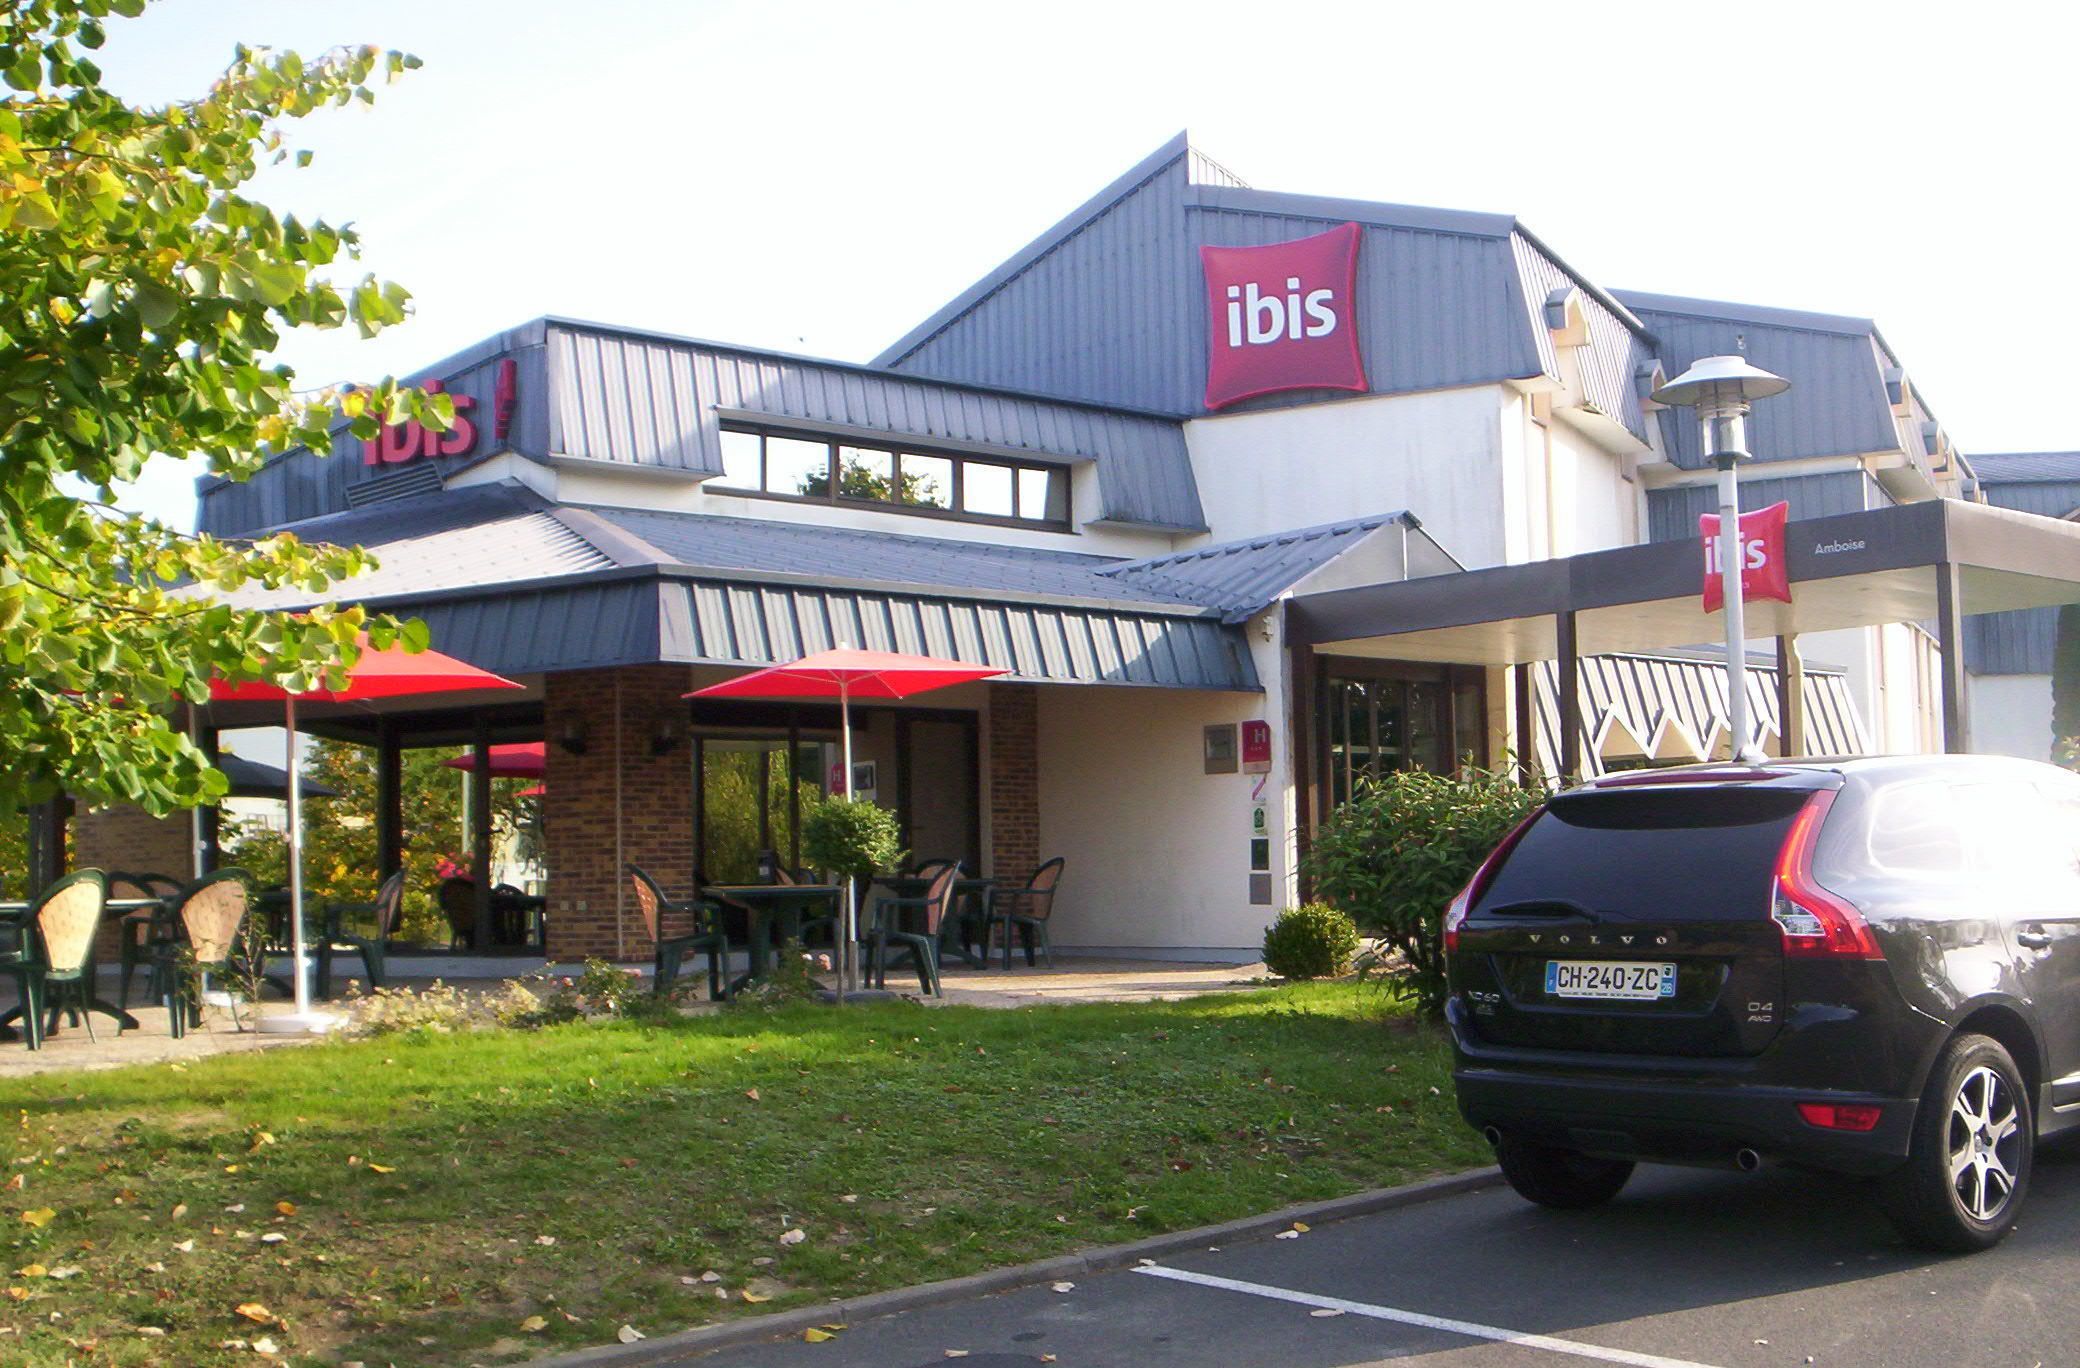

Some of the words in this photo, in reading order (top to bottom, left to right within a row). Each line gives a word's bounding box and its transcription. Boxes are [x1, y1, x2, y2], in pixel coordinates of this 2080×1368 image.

[1227, 277, 1338, 348] ibis
[1814, 539, 1865, 554] Amboise
[1529, 934, 1667, 945] VOLVO
